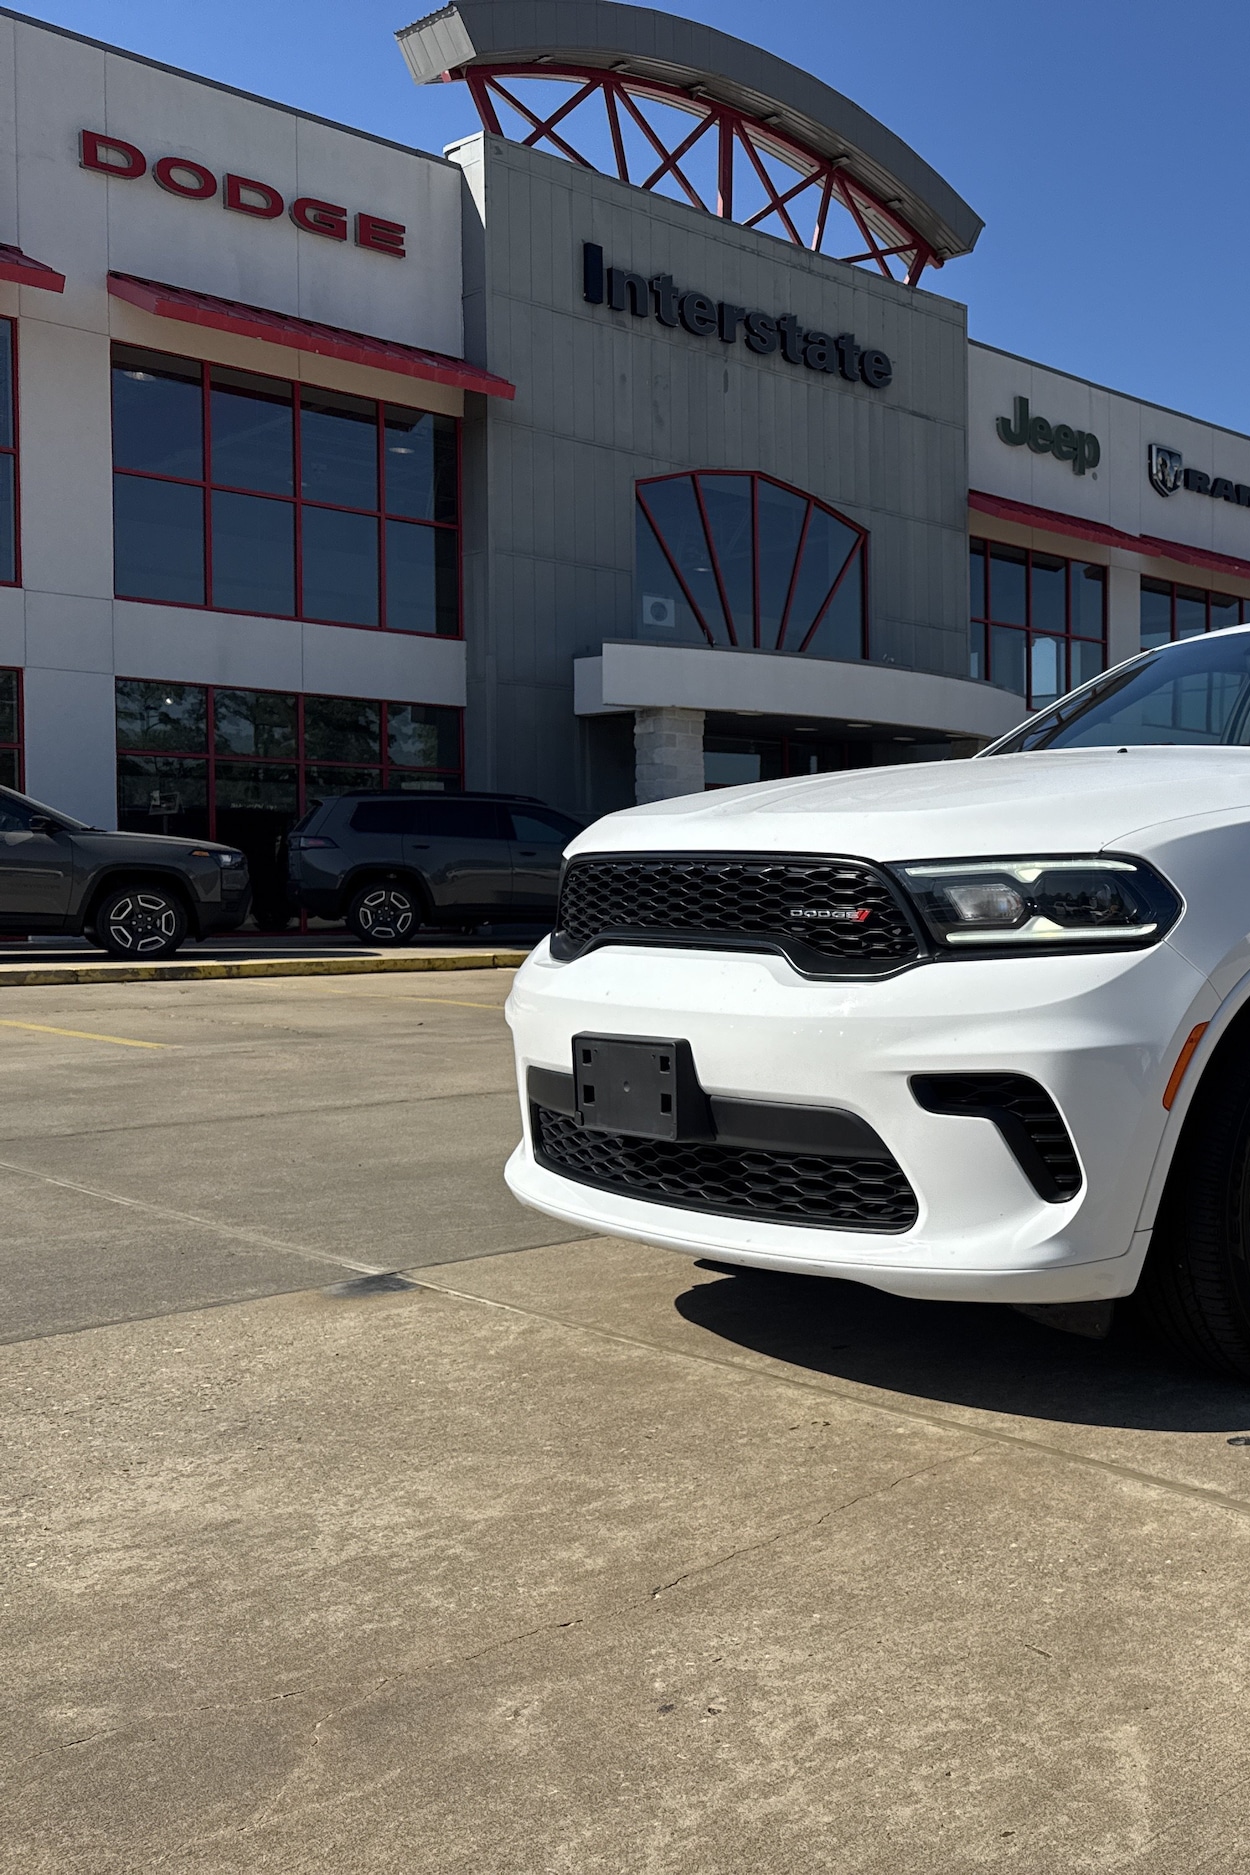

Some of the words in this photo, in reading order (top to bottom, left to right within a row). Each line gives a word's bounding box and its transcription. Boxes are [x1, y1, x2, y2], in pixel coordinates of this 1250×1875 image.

[79, 129, 406, 258] DODGE
[583, 242, 893, 388] Interstate
[996, 396, 1100, 475] Jeep
[790, 909, 859, 919] DODGE
